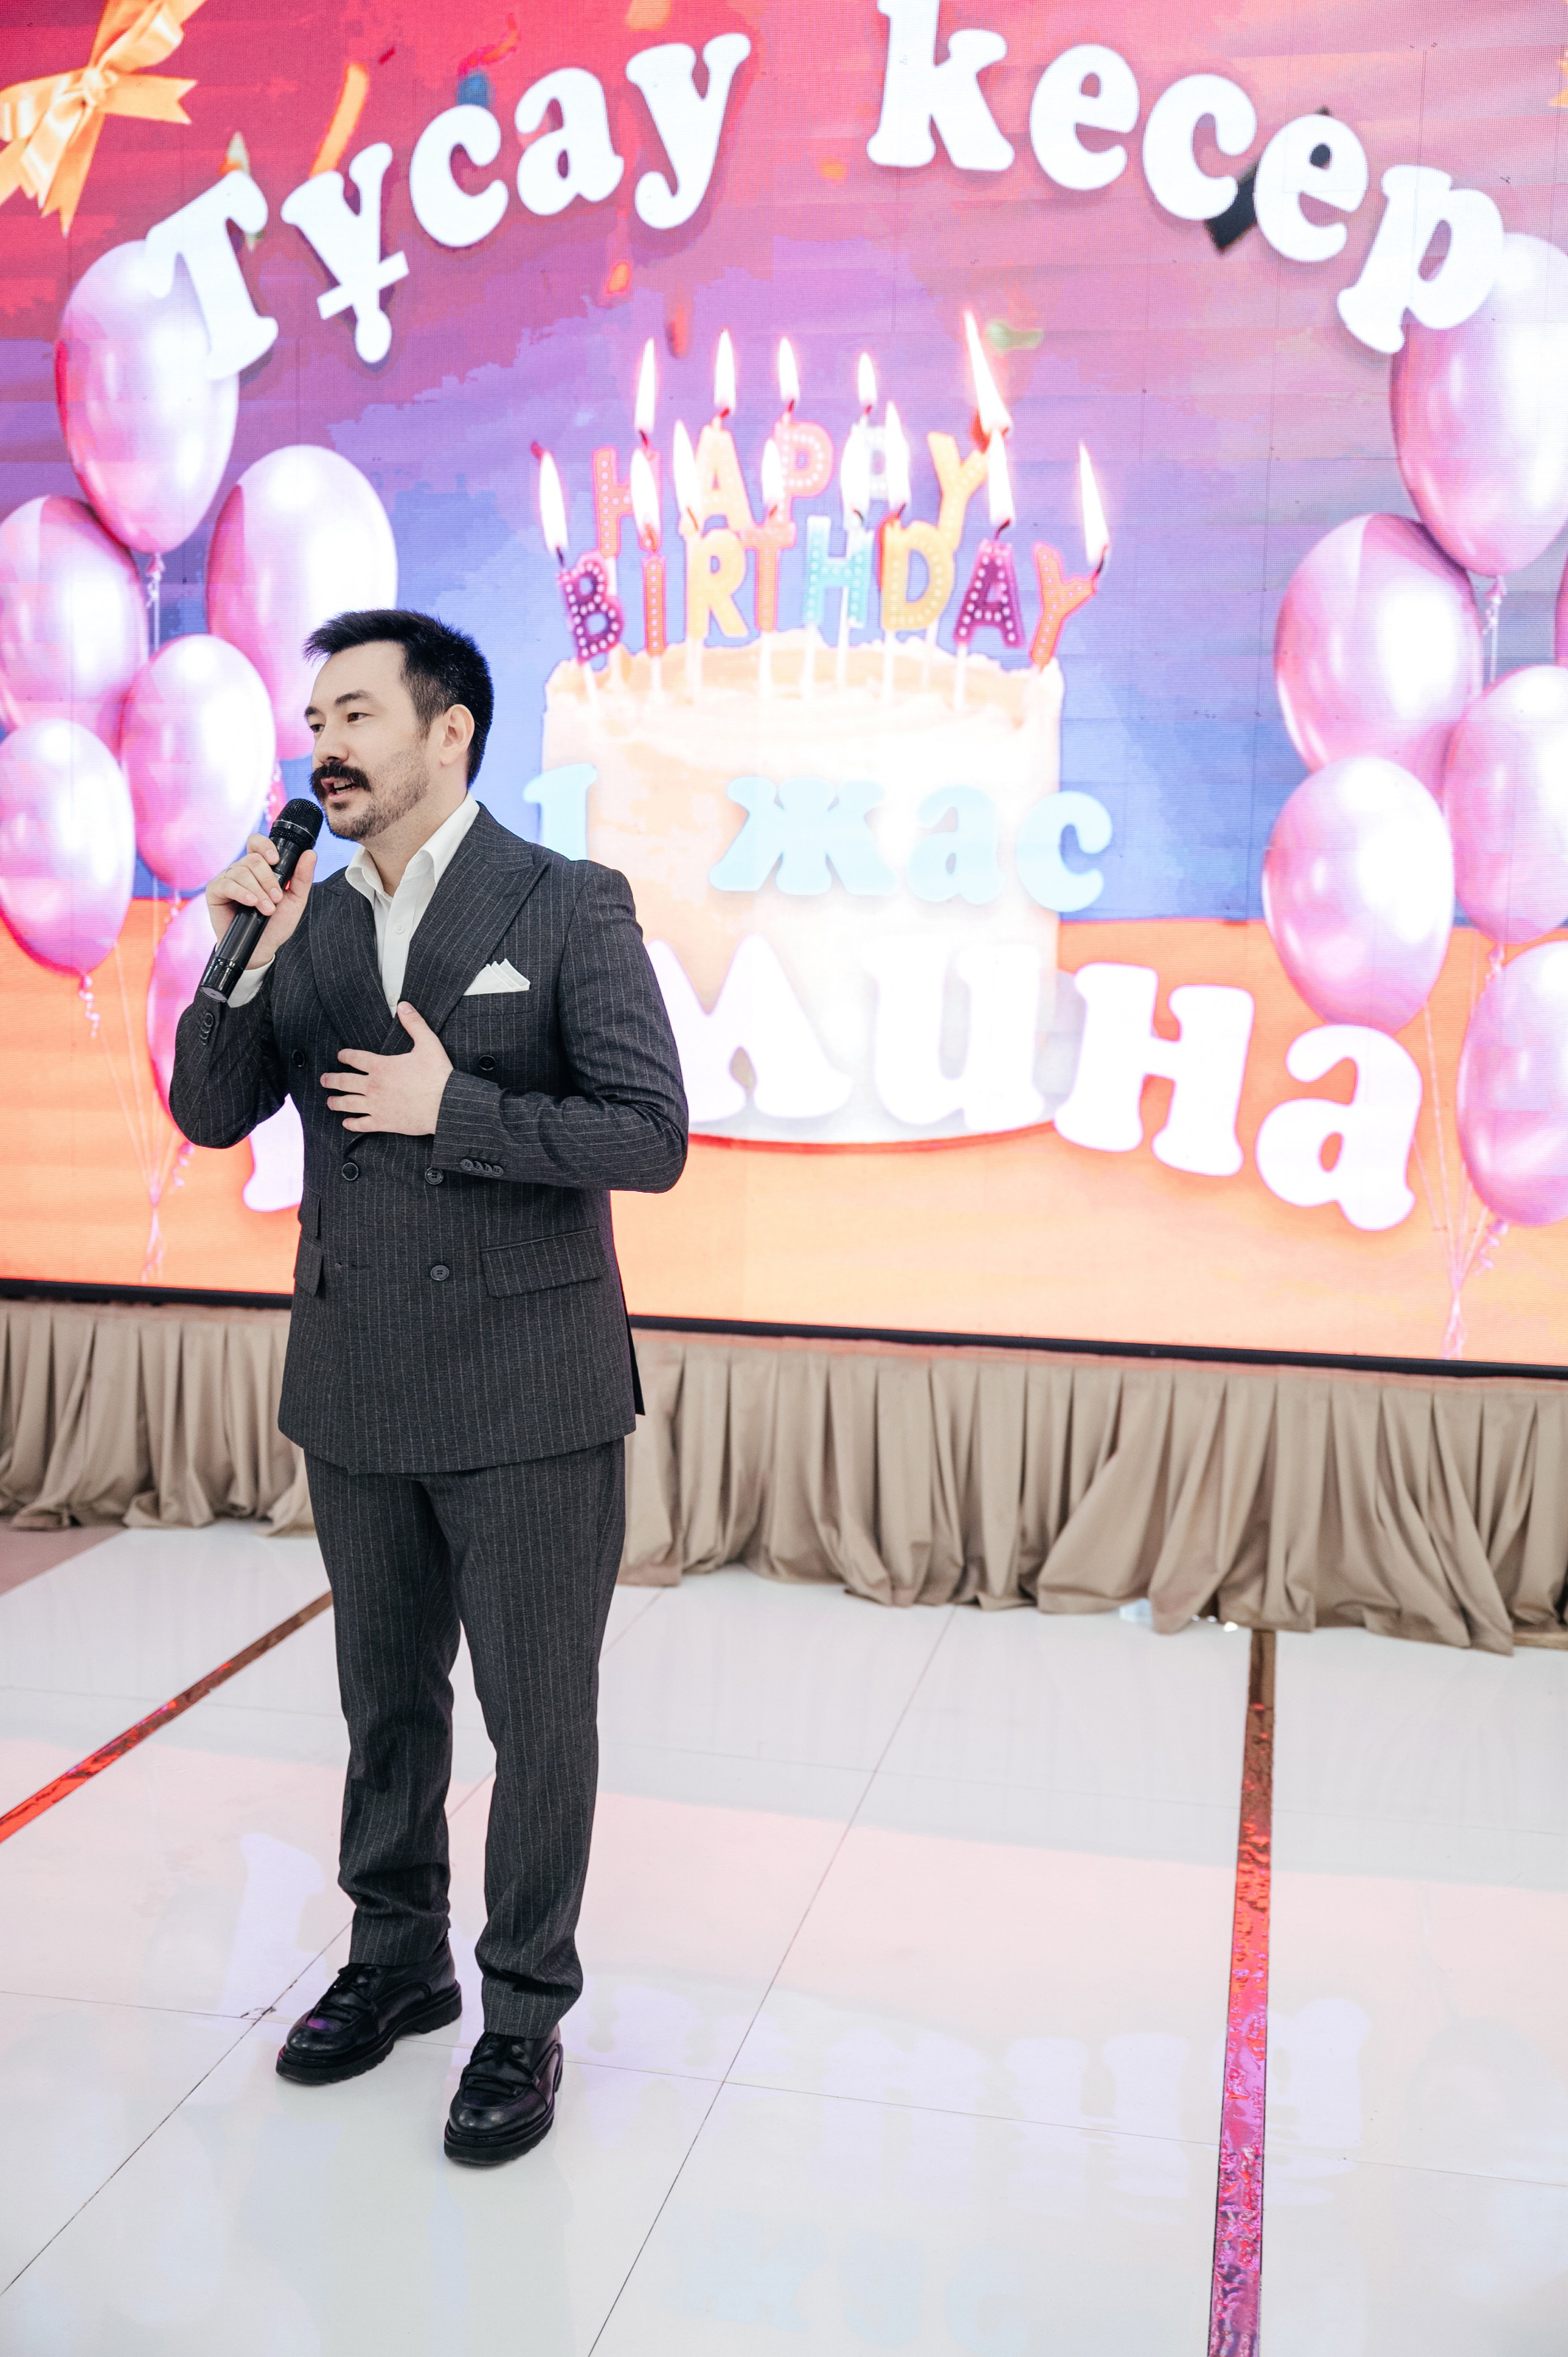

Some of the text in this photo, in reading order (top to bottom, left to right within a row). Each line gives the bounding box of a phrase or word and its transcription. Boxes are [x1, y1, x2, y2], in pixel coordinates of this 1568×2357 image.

[592, 418, 991, 558] HAPPY
[557, 513, 1099, 673] BIRTHDAY
[709, 776, 1113, 913] жас
